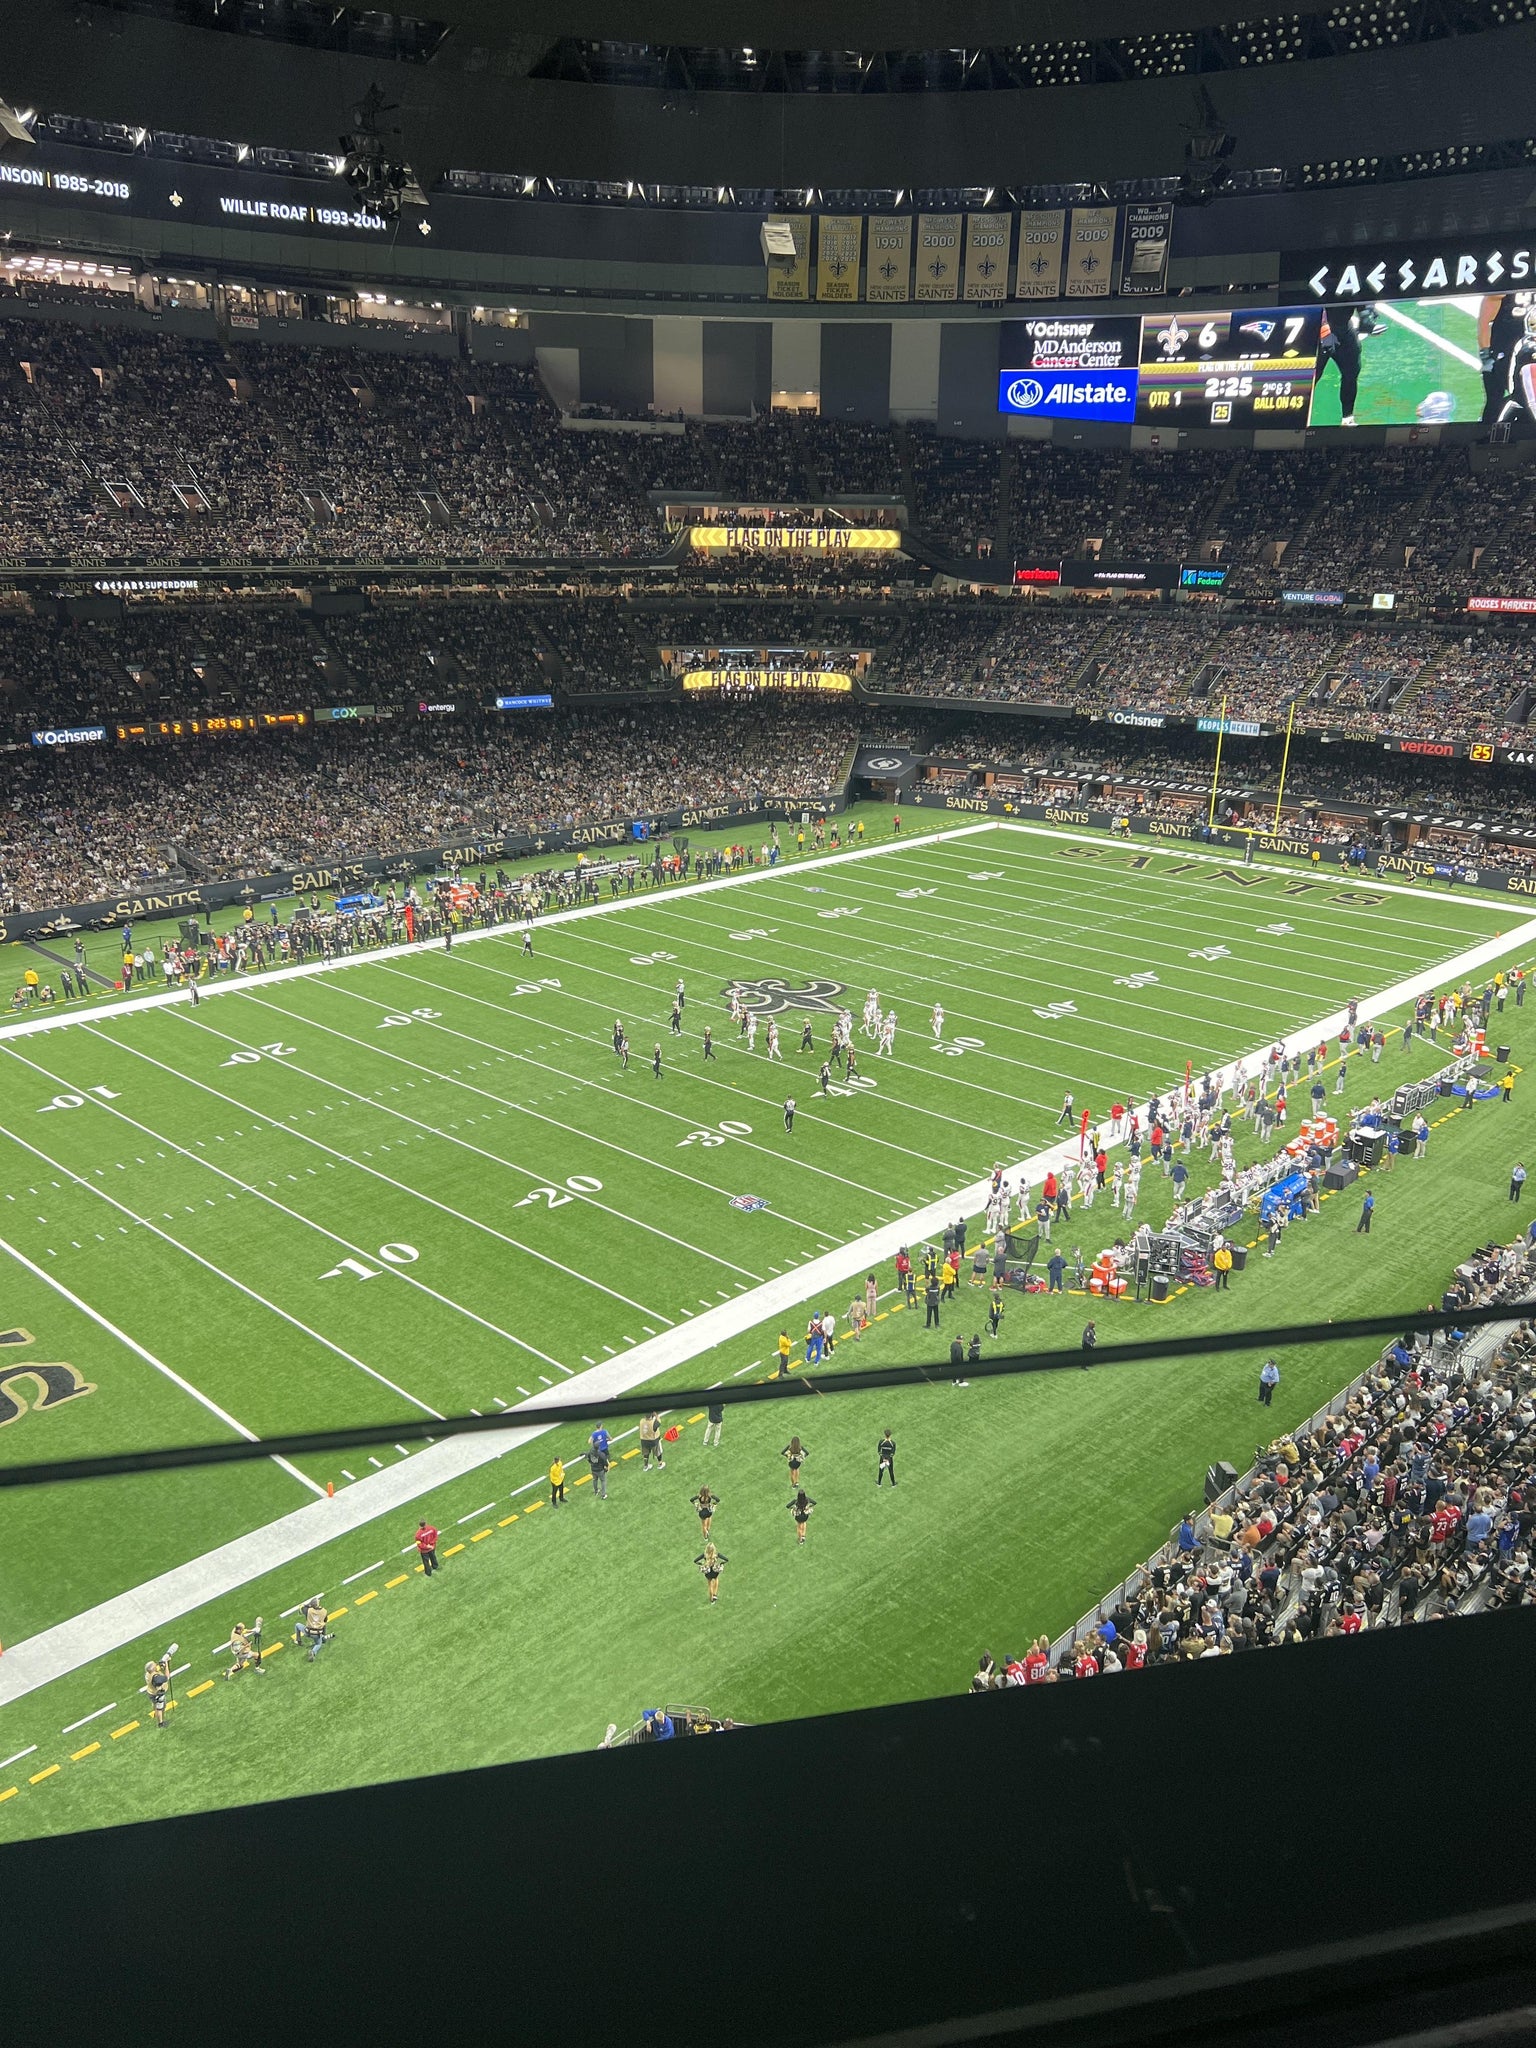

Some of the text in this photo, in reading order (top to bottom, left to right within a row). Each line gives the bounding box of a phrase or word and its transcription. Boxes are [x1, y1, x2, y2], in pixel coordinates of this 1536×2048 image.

[0, 166, 130, 199] NSON 1985-2018
[220, 197, 268, 217] WILLIE
[270, 203, 308, 222] ROAF
[1129, 213, 1169, 222] CHAMPIONS
[1025, 231, 1058, 244] 2009
[1076, 229, 1109, 241] 2009
[1131, 226, 1164, 239] 2009
[875, 237, 904, 249] 1991
[923, 235, 955, 247] 2000
[972, 234, 1005, 247] 2006
[1309, 250, 1505, 298] CAESARS
[869, 290, 906, 300] SAINTS
[917, 288, 954, 298] SAINTS
[967, 288, 1004, 298] SAINTS
[1019, 285, 1056, 296] SAINTS
[1068, 284, 1107, 295] SAINTS
[231, 315, 258, 324] WWL
[1034, 321, 1094, 337] Ochsner
[1199, 322, 1218, 348] 6
[1284, 317, 1304, 344] 7
[1033, 338, 1121, 354] MD Anderson
[1032, 353, 1121, 368] Cancer Center
[1214, 361, 1225, 372] ON
[1205, 377, 1253, 397] 2:25
[1149, 390, 1182, 408] QTR 1
[1253, 395, 1304, 410] BALL ON 43
[1214, 406, 1228, 419] 25
[726, 528, 851, 548] FLAG ON THE PLAY
[71, 558, 106, 567] SAINTS
[146, 558, 181, 567] SAINTS
[219, 558, 252, 566] SAINTS
[288, 558, 319, 566] SAINTS
[355, 557, 385, 566] SAINTS
[417, 557, 446, 566] SAINTS
[478, 557, 506, 566] SAINTS
[1016, 568, 1059, 581] verizon
[94, 580, 199, 590] CAESARS SUPERDOME
[1245, 589, 1273, 598] SAINTS
[1282, 592, 1342, 602] VENTURE GLOBAL
[1404, 595, 1436, 604] SAINTS
[1469, 599, 1536, 611] ROUSES MARKETS
[712, 672, 821, 688] FLAG ON THE PLAY
[331, 707, 357, 719] COX
[428, 703, 455, 712] entergy
[1075, 706, 1103, 717] SAINTS
[1114, 711, 1164, 729] Ochsner
[1231, 721, 1260, 734] HEALTH
[44, 729, 104, 745] Ochsner
[1344, 731, 1376, 743] SAINTS
[1400, 740, 1454, 757] verizon
[1473, 746, 1491, 760] 25
[1021, 767, 1255, 798] CAESARS SUPERDOME
[946, 797, 989, 812] SAINTS
[682, 805, 729, 827] SAINTS
[1045, 807, 1089, 824] SAINTS
[1374, 808, 1502, 833] CAESARS
[572, 822, 626, 844] SAINTS
[1260, 837, 1310, 855] SAINTS
[1050, 847, 1392, 907] SAINTS
[116, 889, 201, 915] SAINTS
[728, 927, 769, 941] 40
[1256, 922, 1295, 936] 10
[629, 951, 679, 966] 50
[1188, 945, 1232, 962] 20
[516, 977, 562, 994] 40
[1112, 971, 1160, 989] 30
[384, 1007, 443, 1027] 30
[1032, 1000, 1079, 1020] 40
[230, 1041, 297, 1066] 20
[929, 1036, 985, 1057] 50
[822, 1075, 878, 1099] 40
[51, 1084, 123, 1109] 10
[690, 1120, 753, 1148] 30
[530, 1175, 604, 1209] 20
[335, 1242, 420, 1281] 10
